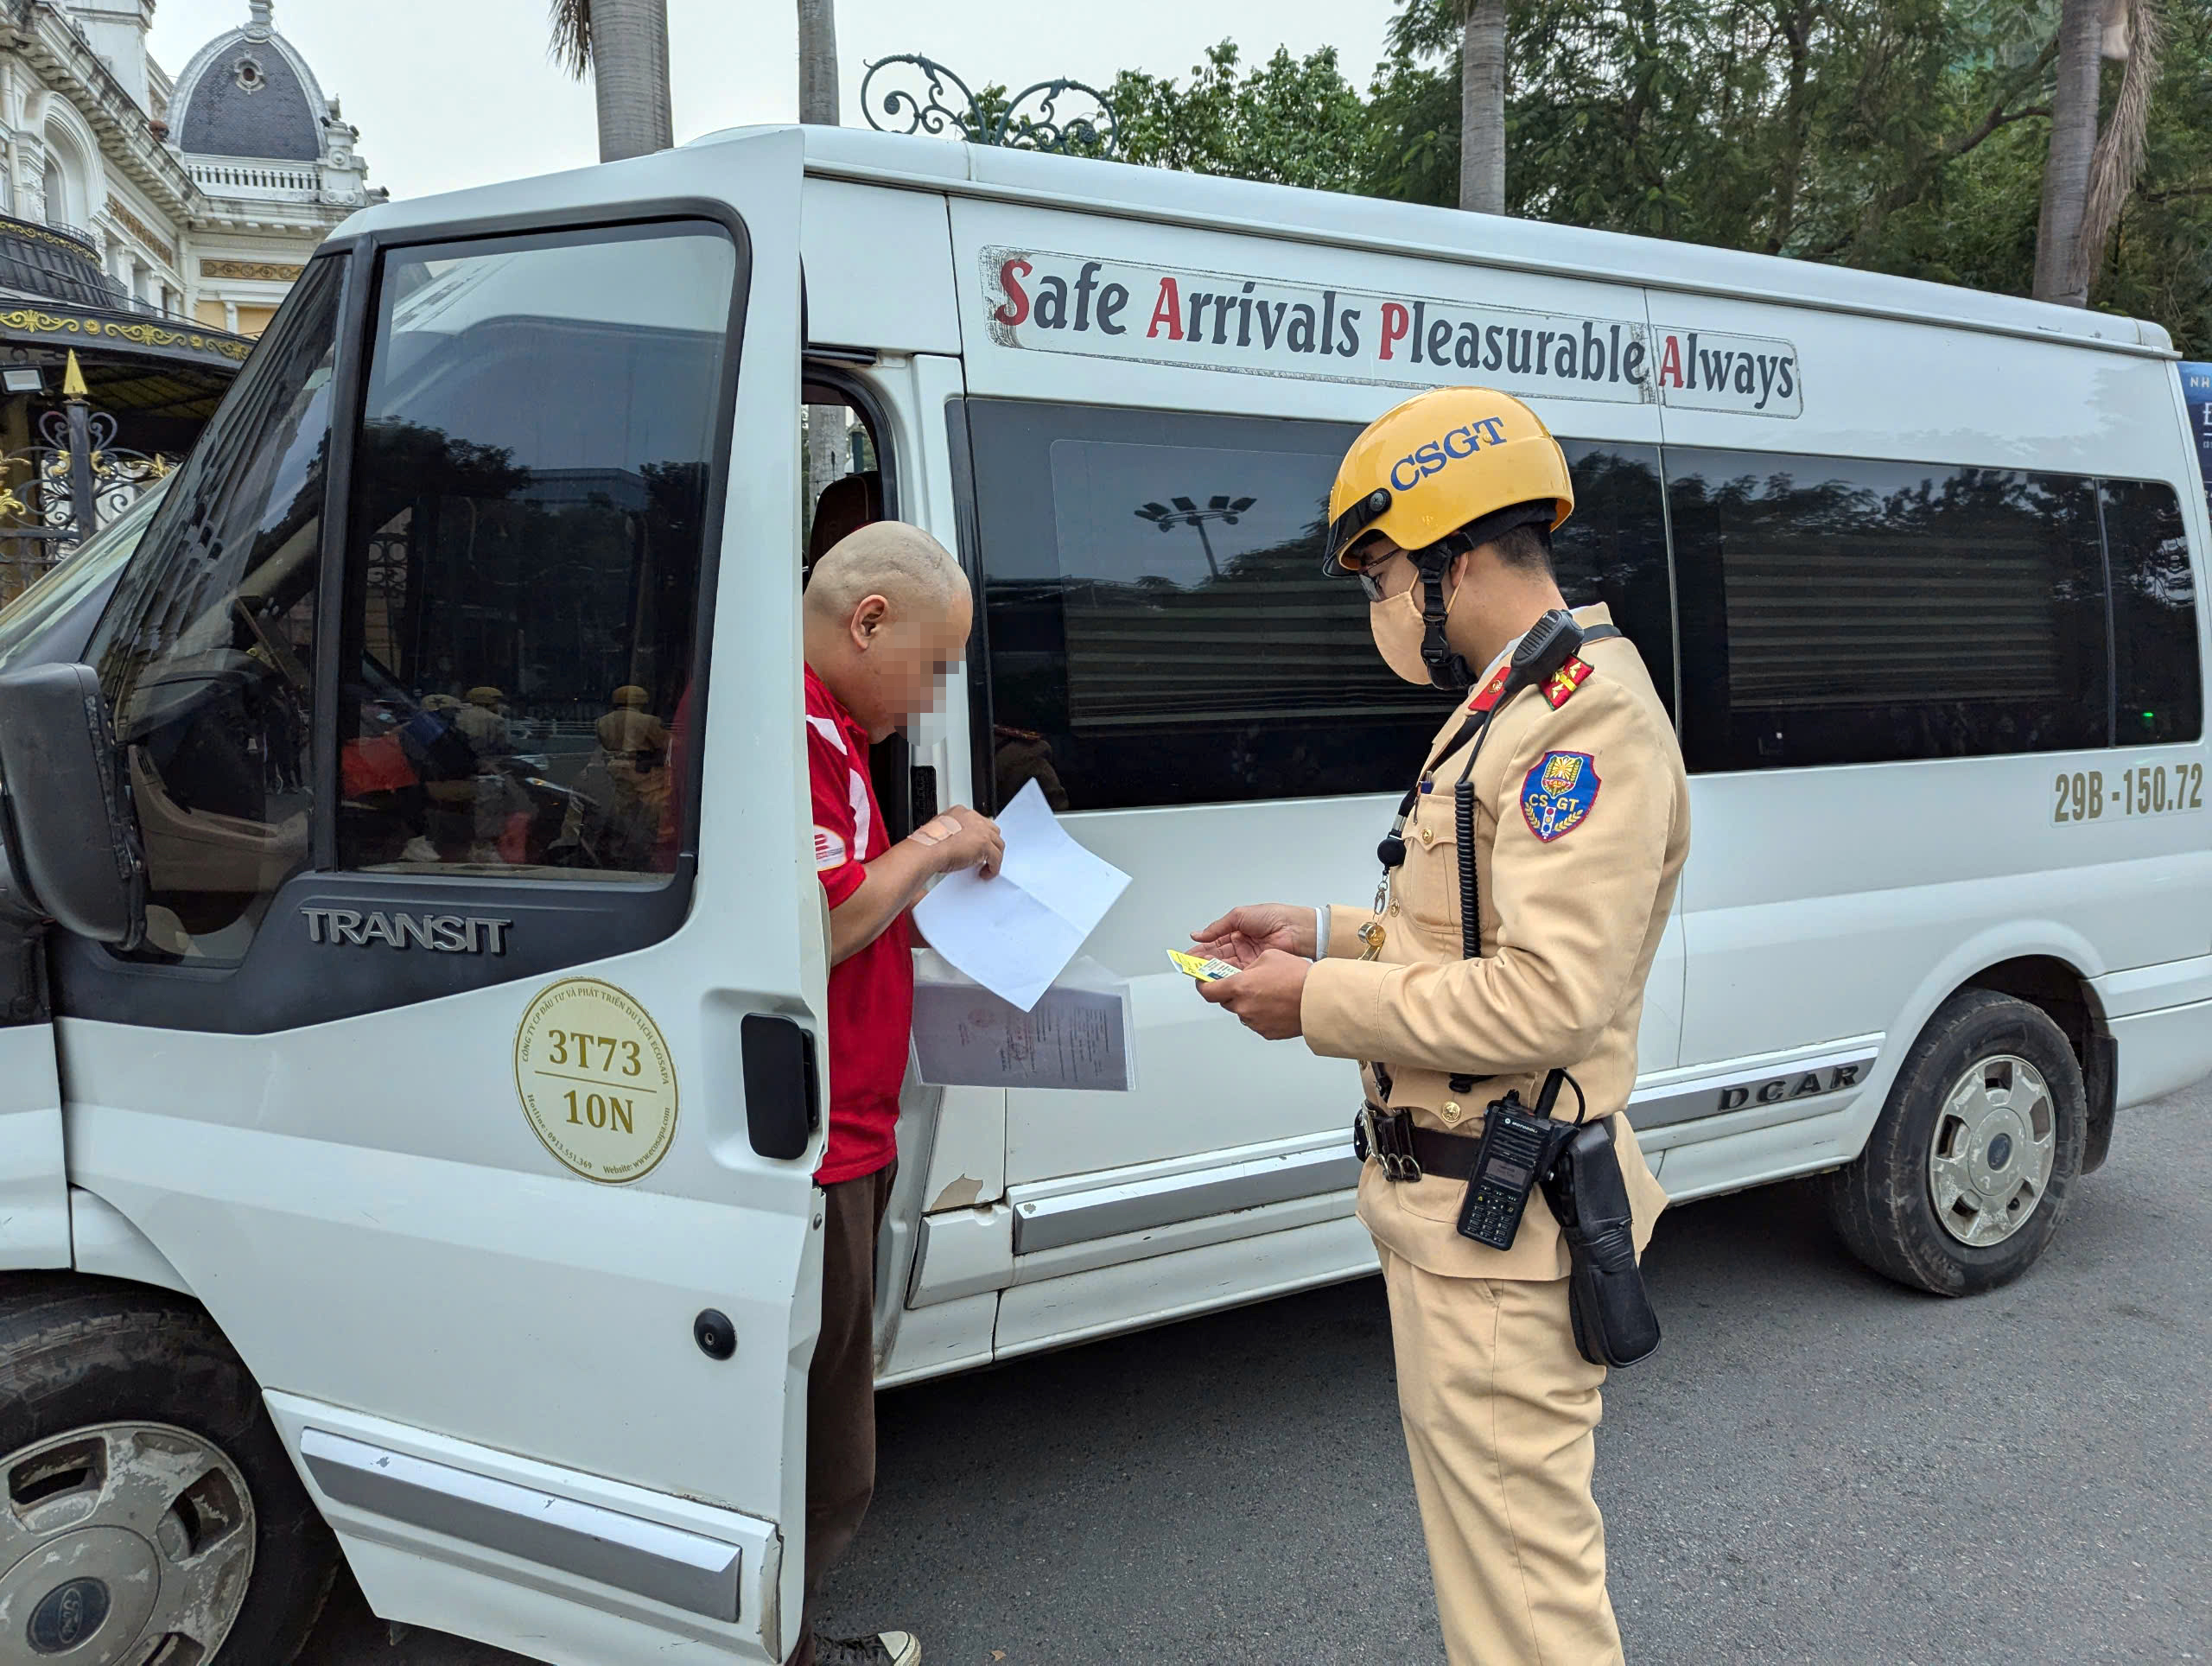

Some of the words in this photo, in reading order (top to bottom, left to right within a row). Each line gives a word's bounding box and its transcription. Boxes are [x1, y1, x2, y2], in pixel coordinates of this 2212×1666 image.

[994, 259, 1129, 335] Safe
[1147, 277, 1361, 358] Arrivals
[1378, 301, 1649, 385] Pleasurable
[1658, 334, 1793, 409] Always
[1390, 416, 1507, 492] CSGT
[300, 907, 512, 953] TRANSIT
[626, 1007, 638, 1021] DU
[548, 1029, 642, 1077] 3T73
[1718, 1065, 1859, 1111] DCAR
[563, 1090, 634, 1135] 10N
